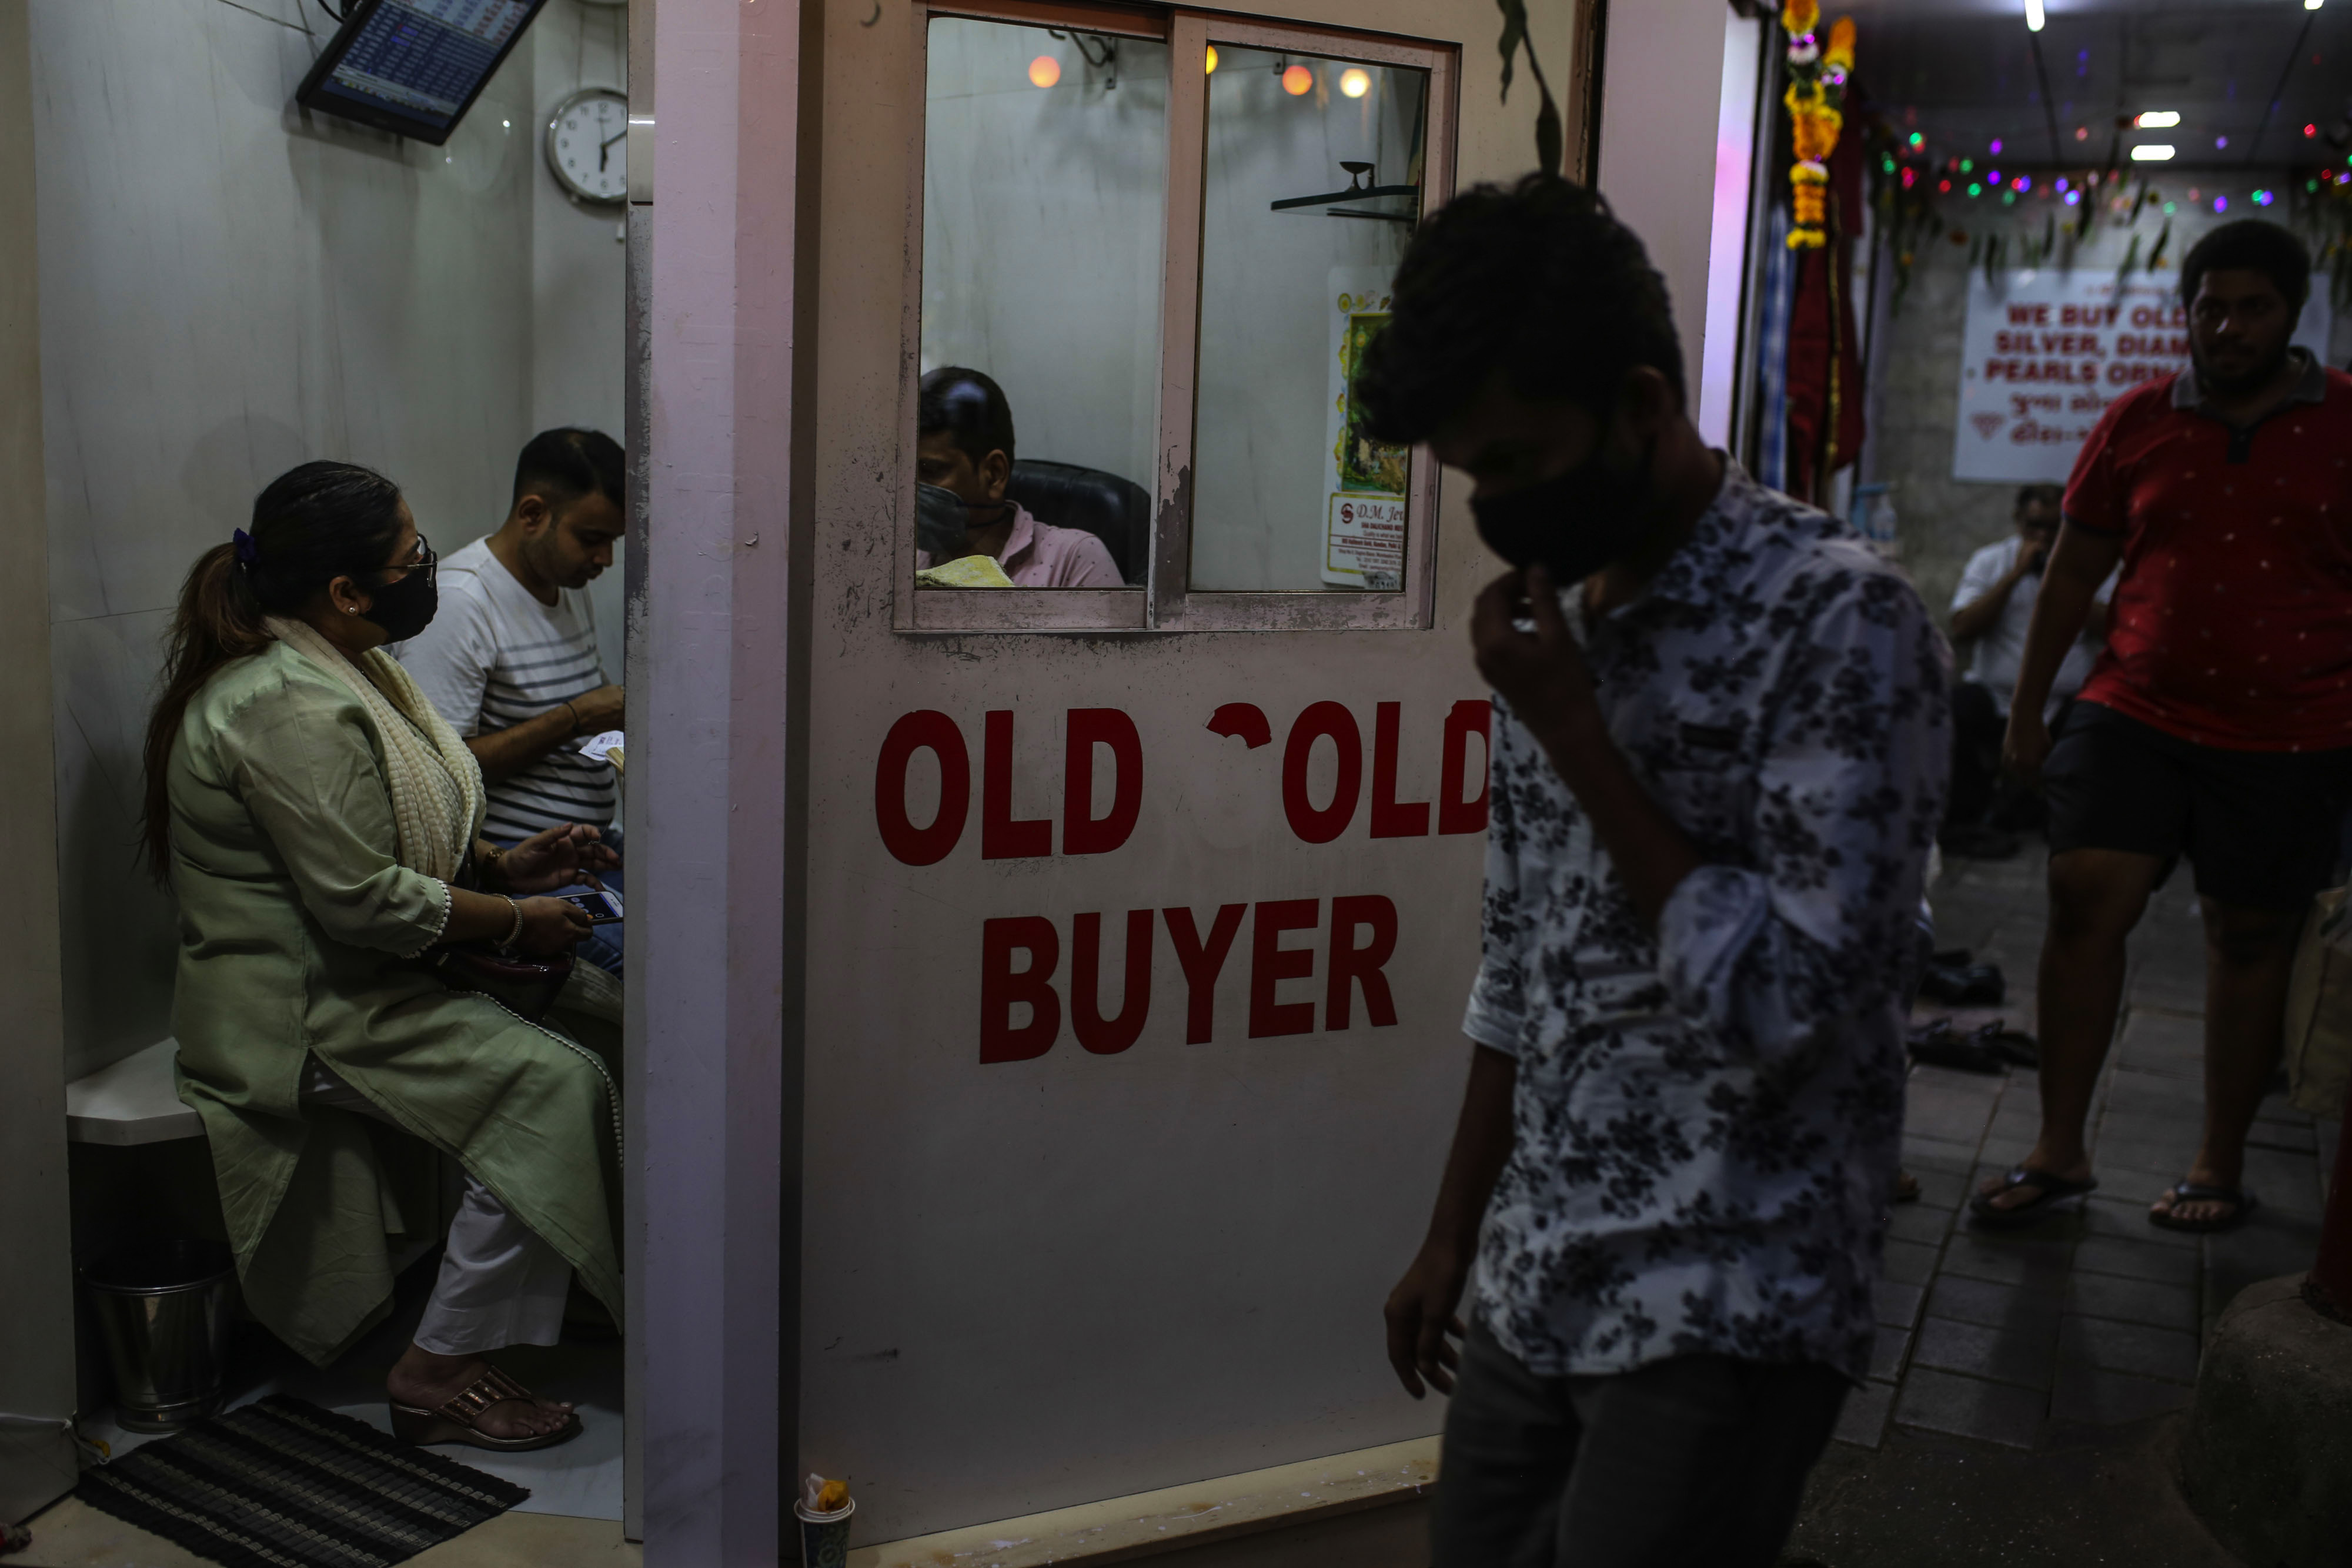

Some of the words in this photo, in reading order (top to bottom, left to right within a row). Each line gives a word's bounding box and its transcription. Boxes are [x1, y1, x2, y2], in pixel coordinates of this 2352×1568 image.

[2009, 305, 2049, 325] WE
[2061, 305, 2119, 327] BUY
[1996, 330, 2106, 357] SILVER,
[1986, 359, 2097, 384] PEARLS
[1357, 504, 1384, 519] D.M.
[876, 707, 1142, 866] OLD
[980, 895, 1398, 1064] BUYER
